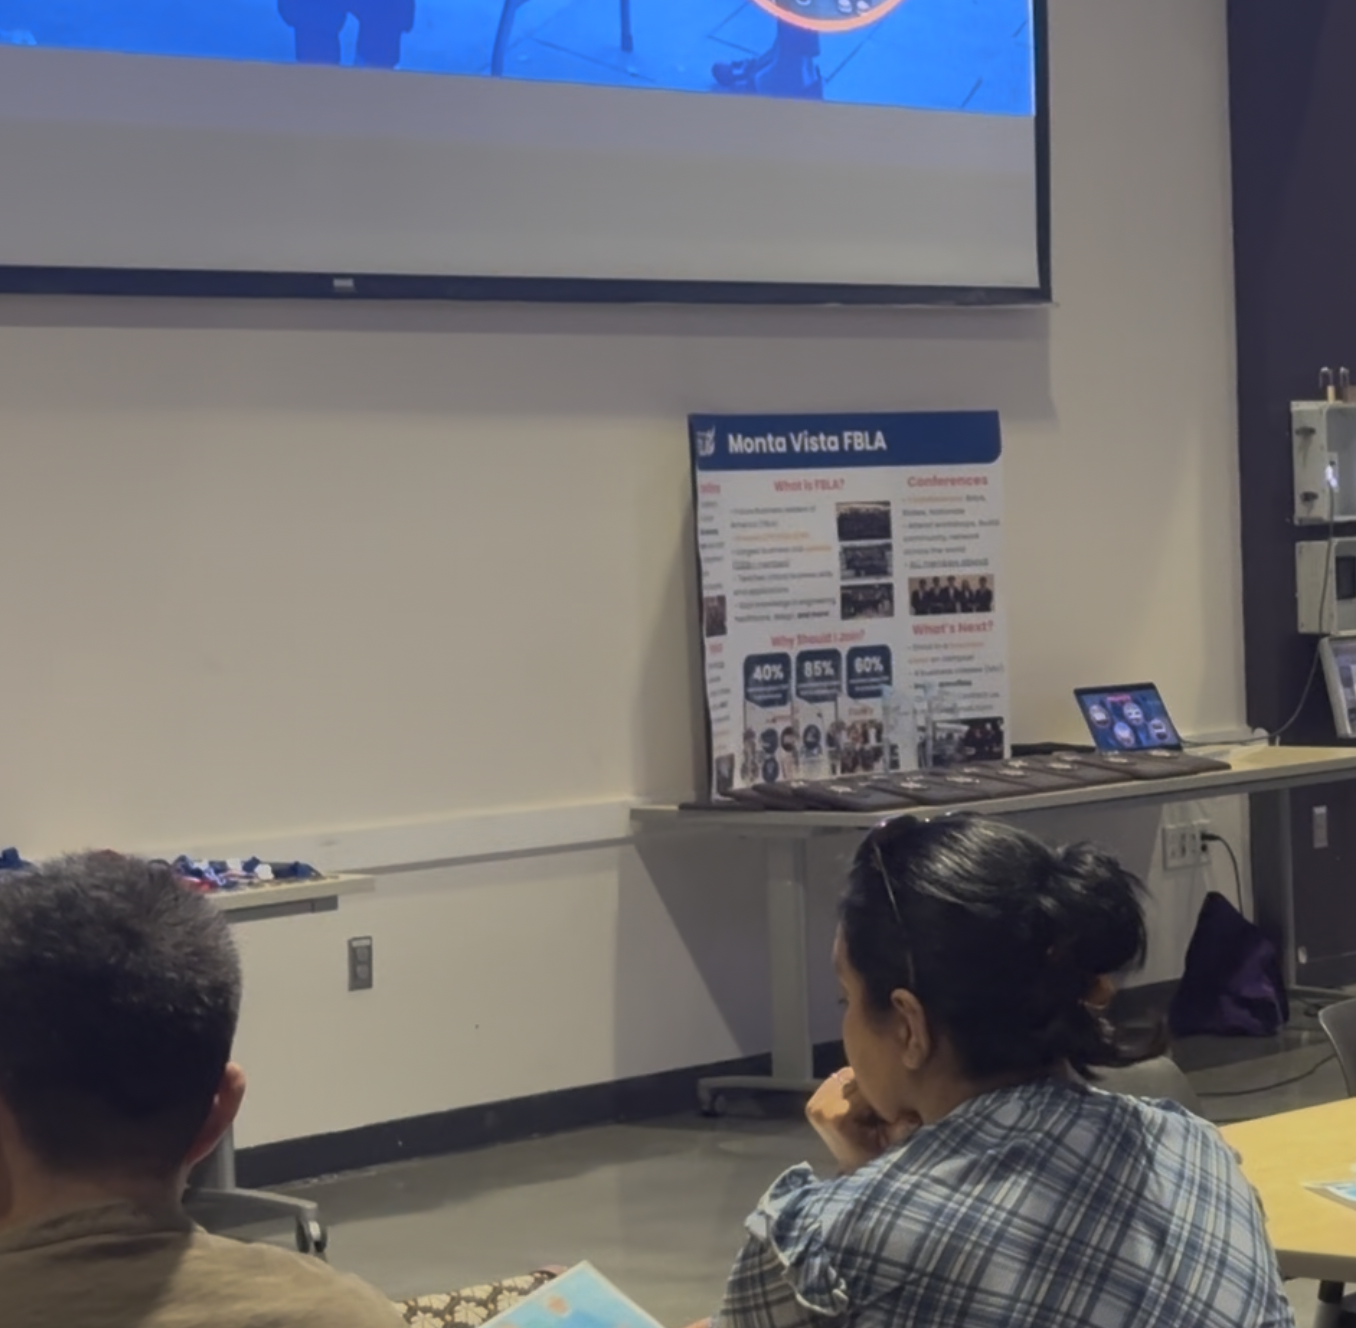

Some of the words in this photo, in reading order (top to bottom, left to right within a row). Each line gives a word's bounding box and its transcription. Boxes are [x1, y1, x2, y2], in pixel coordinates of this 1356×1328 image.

[727, 431, 787, 455] Monta
[789, 429, 840, 454] Vista
[842, 430, 888, 452] FBLA
[773, 479, 802, 493] What
[814, 477, 845, 491] FBLA?
[907, 475, 988, 489] Conferences
[912, 622, 956, 636] What's
[957, 619, 994, 634] Next?
[771, 635, 795, 649] Why
[797, 632, 832, 646] Should
[752, 664, 785, 682] 40%
[803, 659, 836, 678] 85%
[854, 655, 885, 674] 60%
